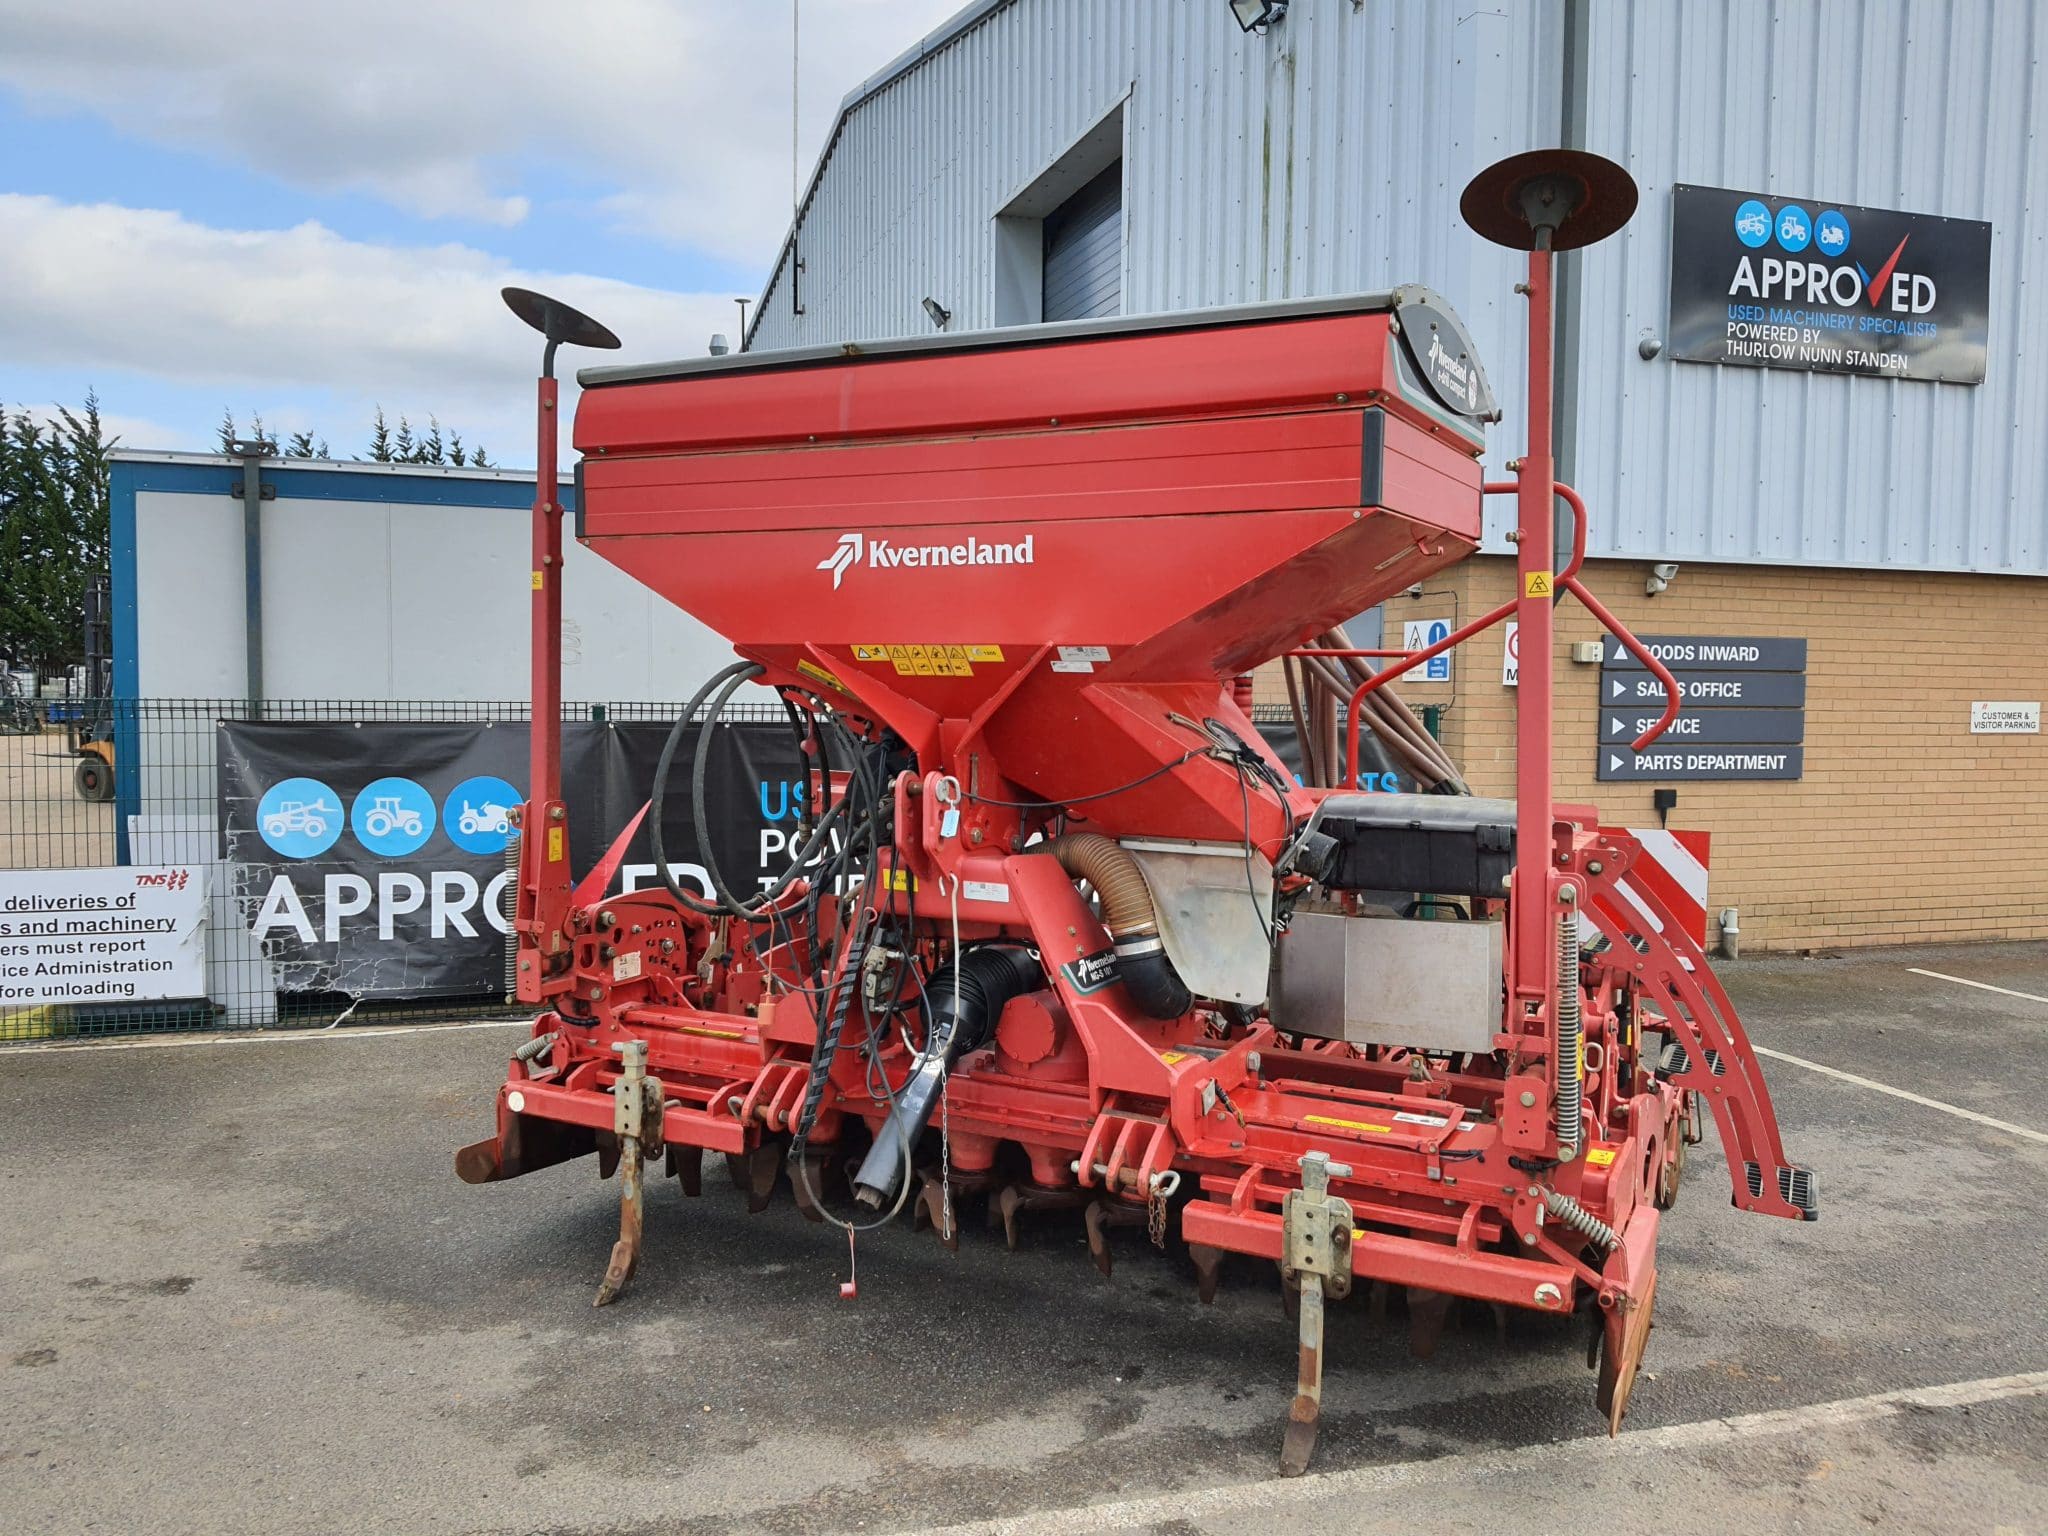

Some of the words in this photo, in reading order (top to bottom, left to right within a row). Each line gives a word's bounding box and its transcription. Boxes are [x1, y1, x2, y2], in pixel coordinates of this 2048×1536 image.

[1728, 304, 1765, 321] USED
[1770, 308, 1855, 330] MACHINERY
[1859, 317, 1937, 338] SPECIALISTS
[1727, 322, 1798, 343] POWERED
[1803, 329, 1821, 344] BY
[1726, 340, 1796, 361] THURLOW
[1800, 347, 1842, 364] NUNN
[1846, 350, 1908, 370] STANDEN
[869, 534, 1034, 568] Kverneland
[1641, 645, 1695, 660] OODS
[1699, 645, 1760, 662] INWARD
[1636, 681, 1687, 697] SALS
[1690, 682, 1742, 697] OFFICE
[1974, 721, 2003, 729] VISITOR
[2004, 721, 2036, 729] PARKING
[1981, 712, 2022, 720] CUSTOMER
[2024, 712, 2030, 720] &
[1636, 718, 1701, 734] SEVICE
[1634, 754, 1683, 770] PARTS
[1687, 755, 1787, 770] DEPARTMENT
[136, 874, 168, 887] TNS
[5, 895, 108, 911] deliveries
[115, 892, 137, 908] of
[20, 918, 58, 934] and
[66, 915, 176, 934] machinery
[36, 941, 84, 954] must
[90, 938, 146, 956] report
[0, 963, 29, 977] ice
[35, 958, 173, 976] Administration
[1085, 953, 1117, 972] Kvernelan
[42, 979, 135, 998] unloading
